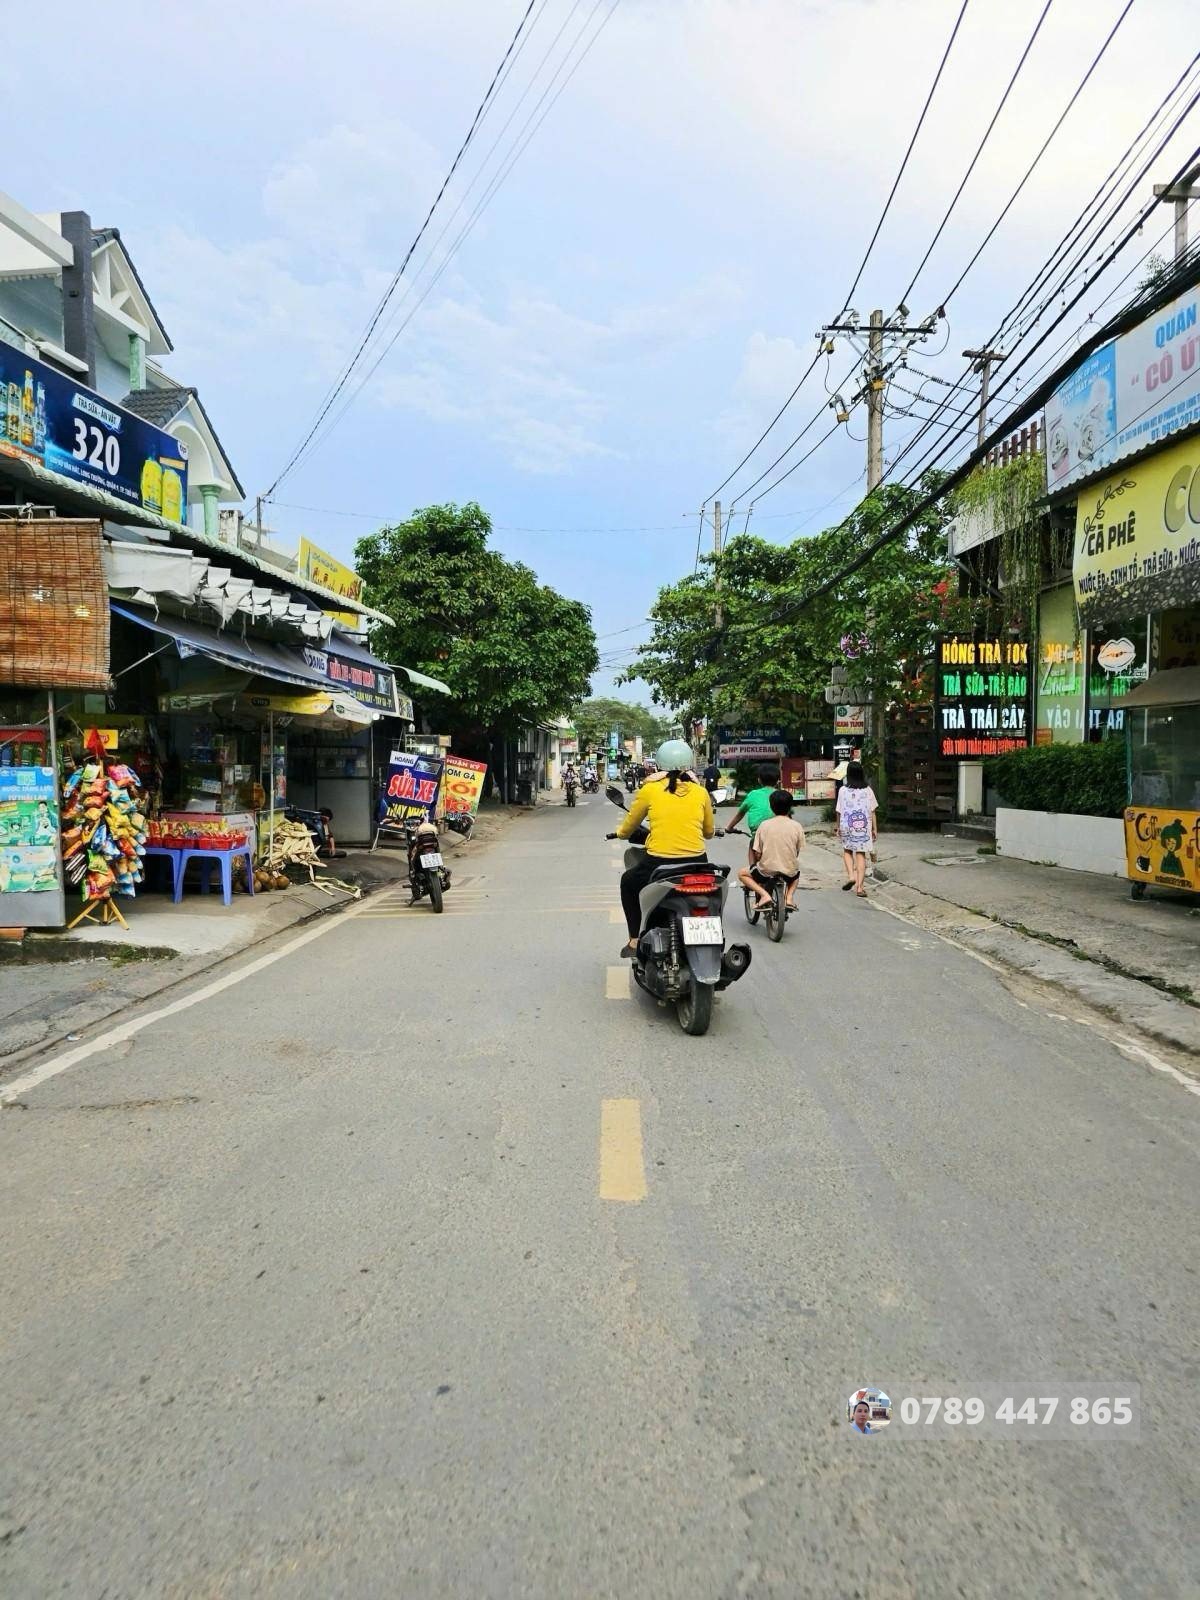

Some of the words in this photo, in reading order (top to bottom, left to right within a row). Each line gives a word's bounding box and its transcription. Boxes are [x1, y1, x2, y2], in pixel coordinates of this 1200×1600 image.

[73, 417, 120, 476] 320
[1107, 511, 1136, 550] PHÊ
[1079, 571, 1096, 595] NƯỚC
[1110, 566, 1127, 587] SINH
[1142, 551, 1157, 576] TRÀ
[942, 636, 975, 664] HỒNG
[978, 638, 1001, 664] TRÀ
[1006, 643, 1028, 664] 10K
[943, 671, 961, 696] TRÀ
[942, 703, 966, 729] TRÀ
[970, 703, 998, 729] TRÁI
[1002, 703, 1025, 729] CÂY
[388, 768, 416, 800] SỬA
[415, 779, 438, 804] XE
[446, 768, 461, 777] ƠM
